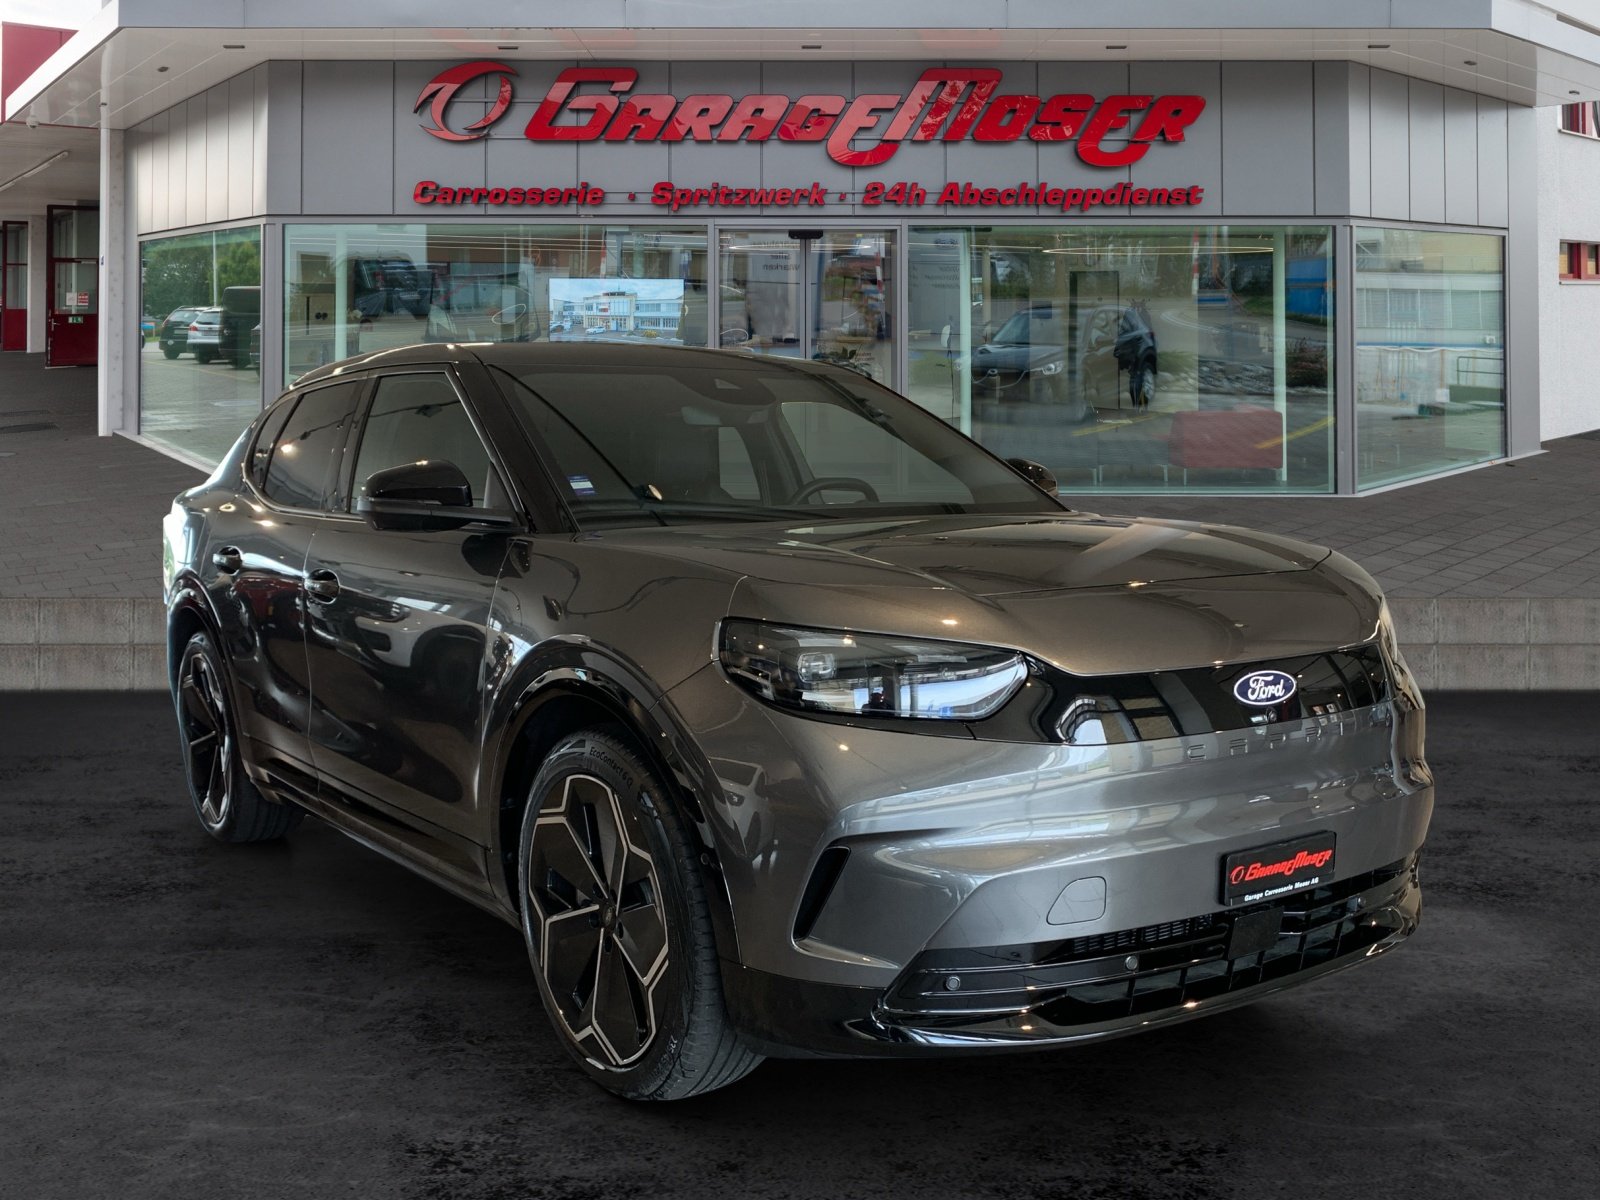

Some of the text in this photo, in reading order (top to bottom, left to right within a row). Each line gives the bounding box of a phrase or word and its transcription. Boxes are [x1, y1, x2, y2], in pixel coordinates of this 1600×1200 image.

[413, 181, 1204, 212] Carrosserie Spritzwerk 24h Abschleppdienst
[1248, 675, 1284, 699] Ford
[1187, 721, 1344, 760] CAPRI
[1244, 892, 1263, 902] Garage
[1294, 880, 1310, 888] Moser
